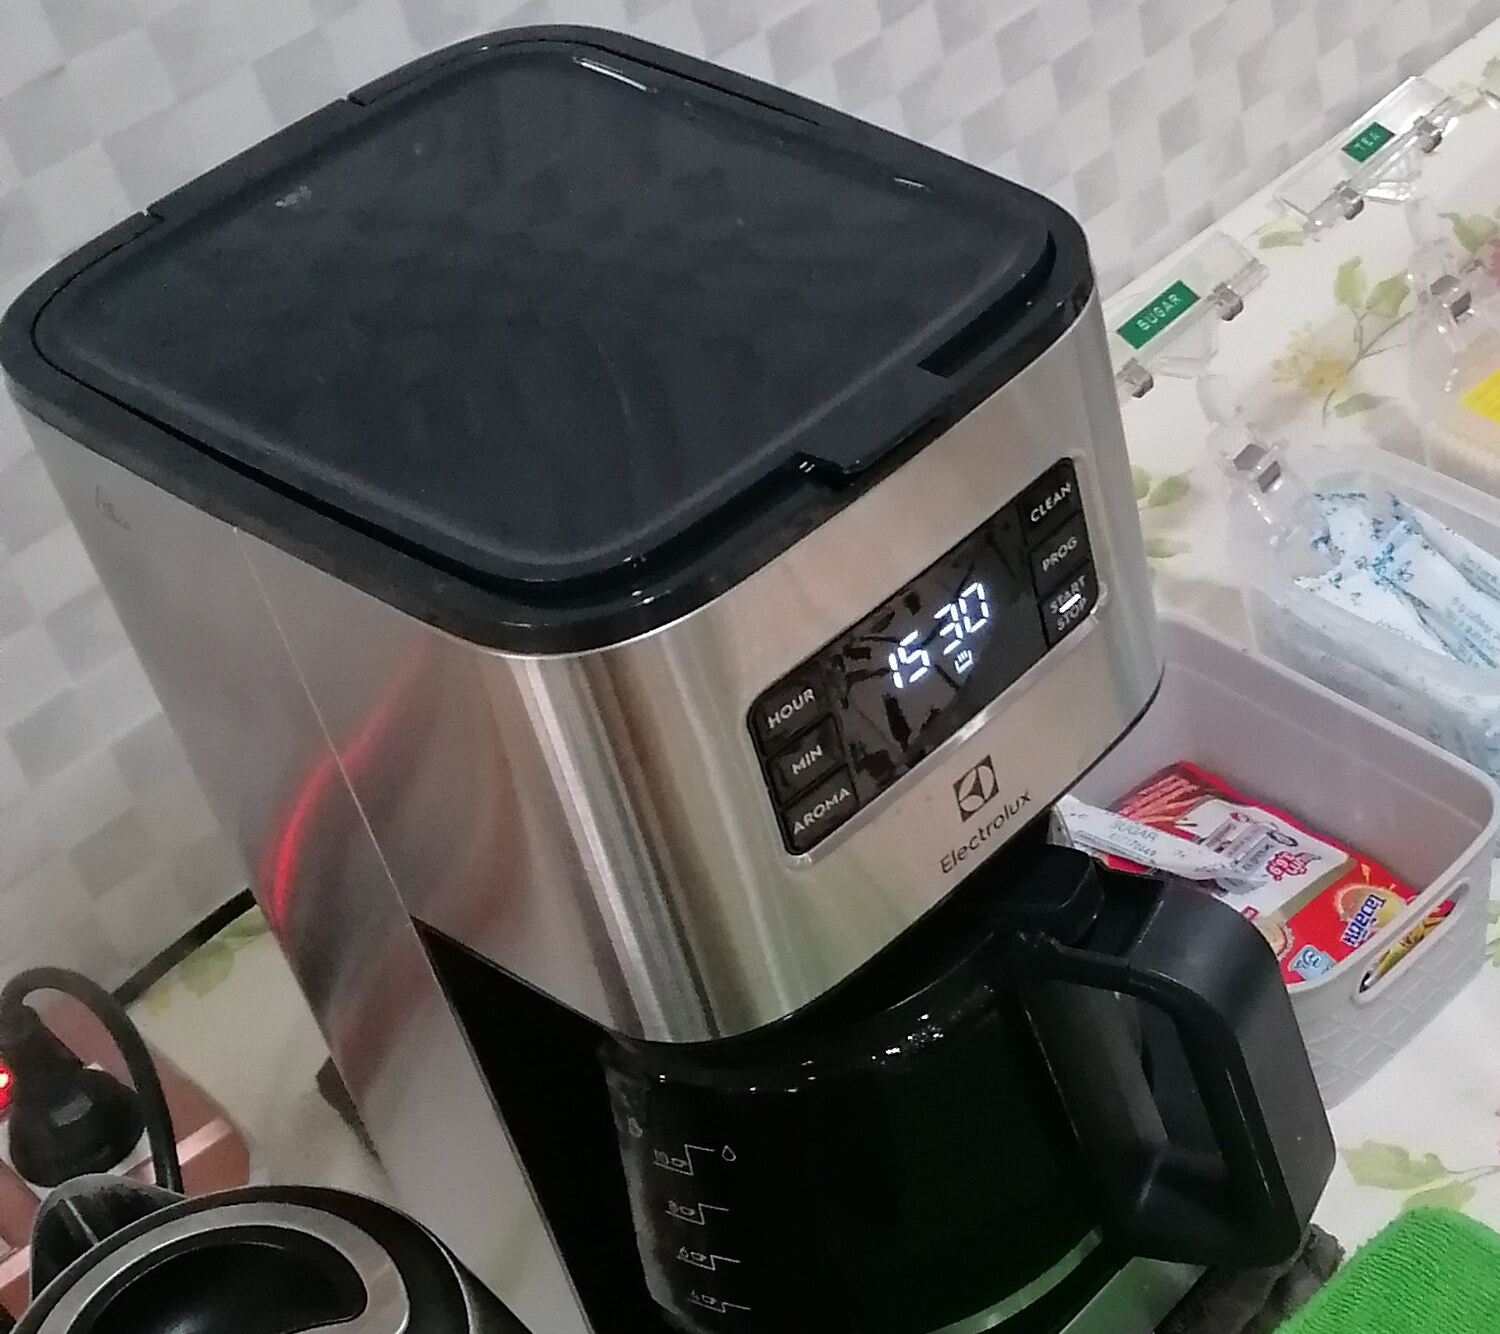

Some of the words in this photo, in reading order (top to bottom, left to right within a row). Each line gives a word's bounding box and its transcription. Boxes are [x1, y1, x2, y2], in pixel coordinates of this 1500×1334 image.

[1136, 293, 1181, 331] SUGAR
[1030, 483, 1072, 522] CLEAN
[1042, 536, 1078, 571] PROG
[1050, 575, 1085, 614] START
[1057, 597, 1087, 631] STOP
[767, 688, 815, 729] HOUR
[791, 744, 824, 775] MIN
[793, 788, 851, 834] AROMA
[940, 790, 1031, 874] Electrolux
